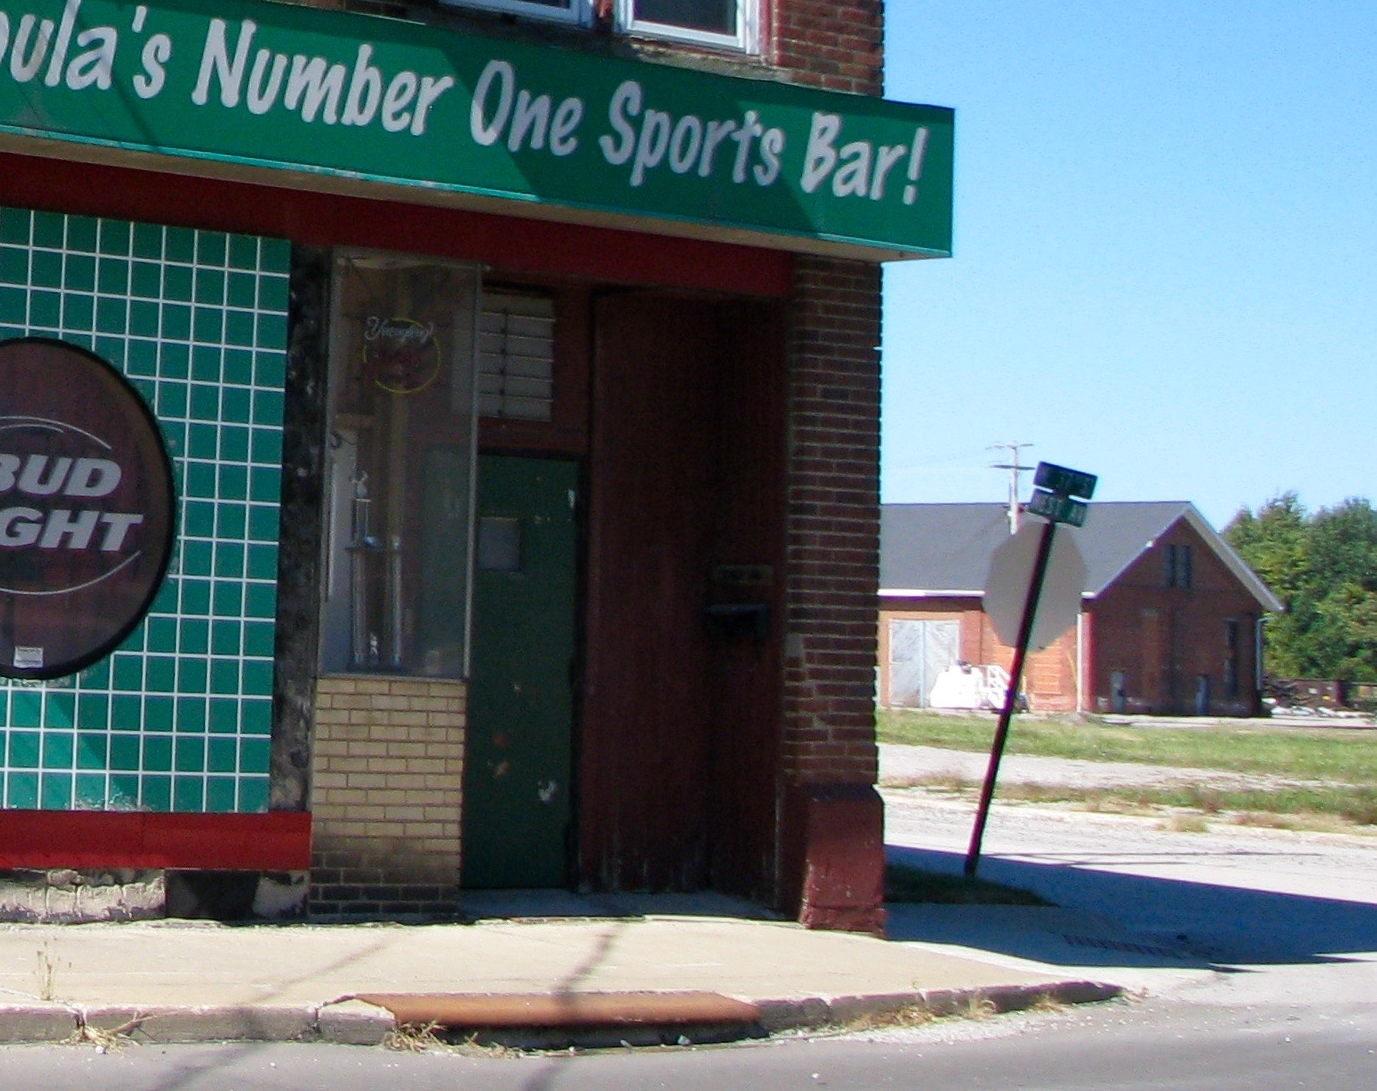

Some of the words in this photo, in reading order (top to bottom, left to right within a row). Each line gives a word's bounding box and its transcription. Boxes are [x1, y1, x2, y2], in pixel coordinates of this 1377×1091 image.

[191, 18, 453, 136] Number
[471, 60, 583, 156] One
[599, 80, 782, 186] Sports
[800, 112, 928, 206] Bar!
